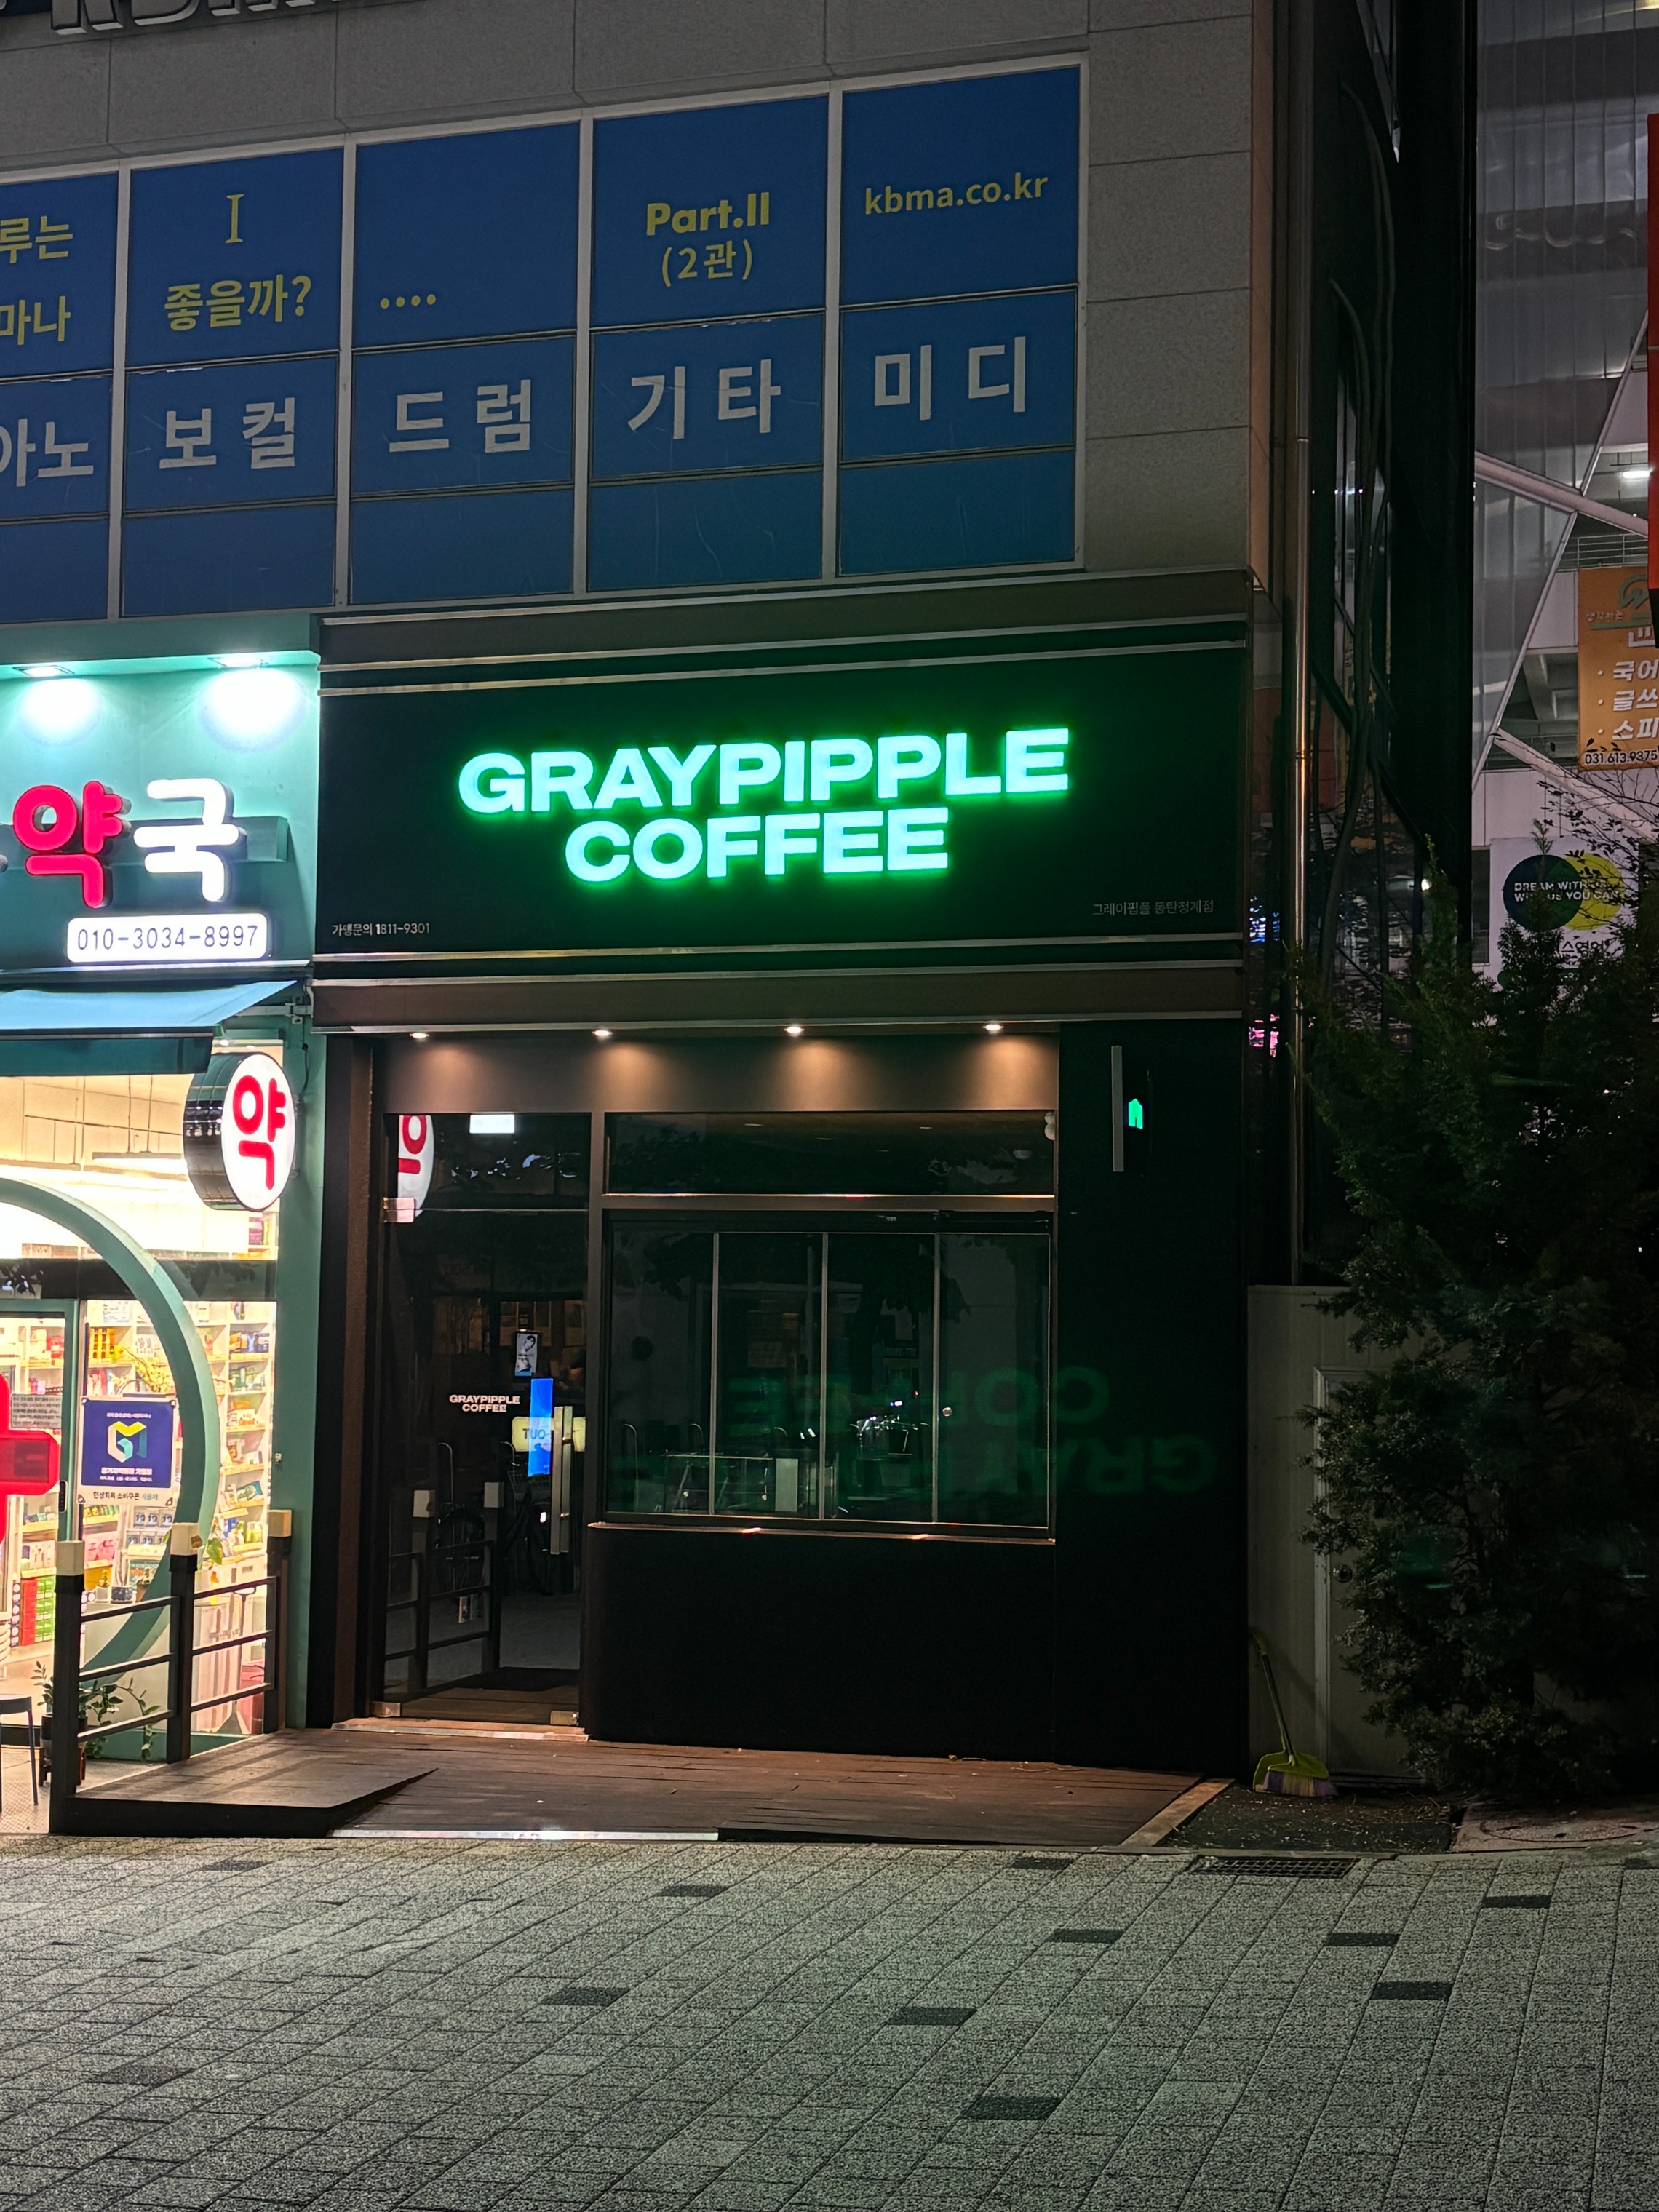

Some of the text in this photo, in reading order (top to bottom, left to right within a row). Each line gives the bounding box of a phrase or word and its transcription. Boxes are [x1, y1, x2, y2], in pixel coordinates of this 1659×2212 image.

[864, 172, 1049, 215] kbma.co.kr
[661, 239, 754, 287] (2관)
[164, 274, 312, 331] 좋을까?
[458, 728, 1069, 813] GRAYPIPPLE
[12, 777, 240, 908] 약국
[565, 808, 949, 882] COFFEE
[1566, 891, 1591, 900] YOU
[77, 925, 259, 951] 010-3034-8997
[375, 923, 430, 935] 1811-9301
[232, 1075, 287, 1190] 약
[449, 1394, 520, 1404] GRAYPIPPLE
[462, 1404, 507, 1412] COFFEE
